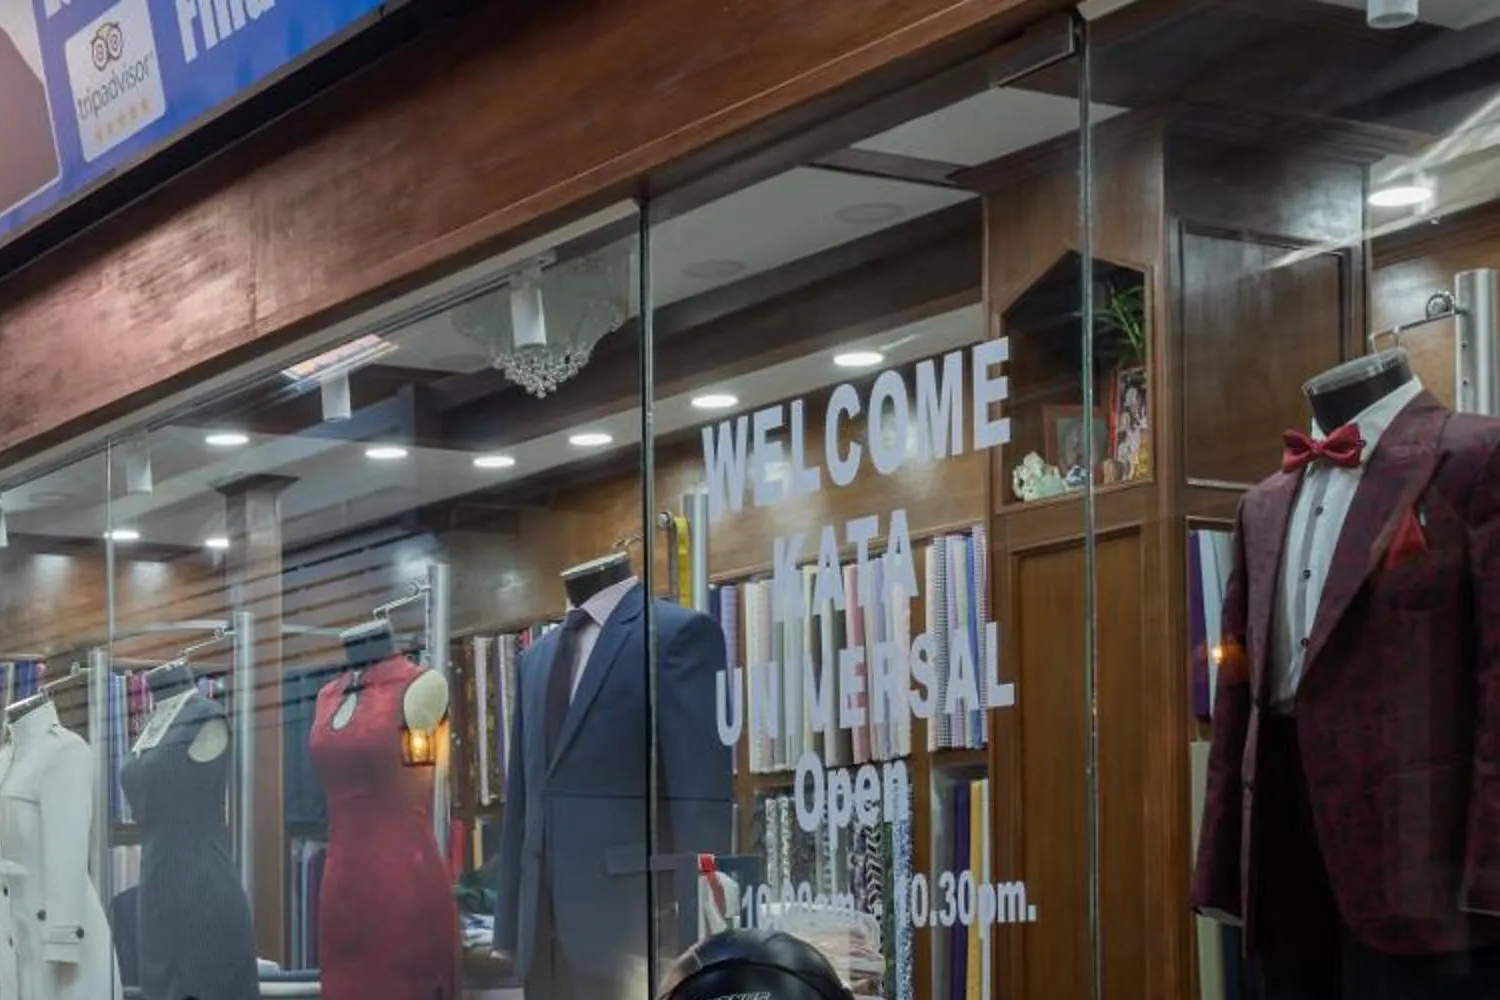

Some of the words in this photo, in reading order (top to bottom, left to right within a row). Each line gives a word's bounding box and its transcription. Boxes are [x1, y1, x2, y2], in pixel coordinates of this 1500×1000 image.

[77, 55, 152, 121] tripadvisor
[701, 337, 1012, 512] WELCOME
[773, 508, 919, 622] KATA
[715, 622, 1015, 746] UNIVERSAL
[794, 750, 910, 850] Open
